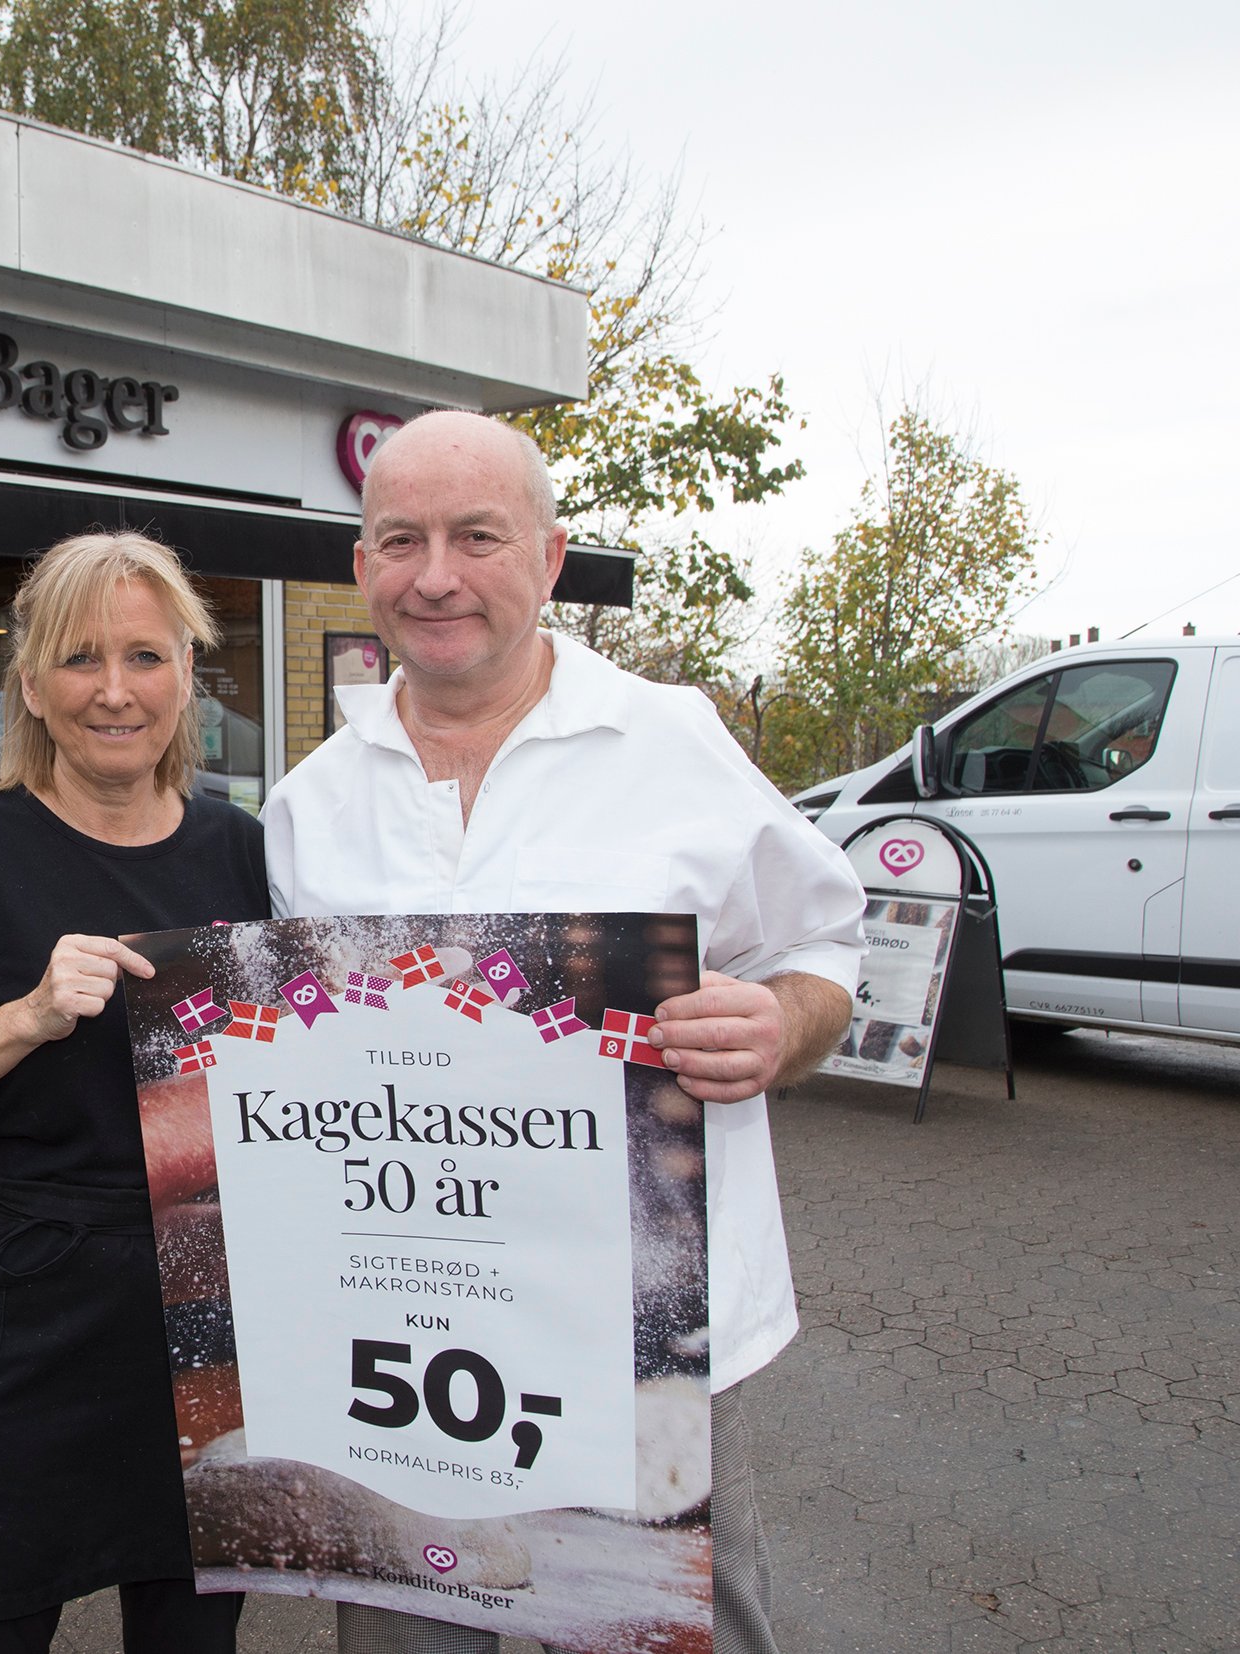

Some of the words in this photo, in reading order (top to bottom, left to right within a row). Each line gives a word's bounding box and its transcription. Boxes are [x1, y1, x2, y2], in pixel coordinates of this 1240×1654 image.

[865, 936, 909, 950] GBRØD
[1029, 1000, 1050, 1009] CVR
[365, 1050, 452, 1067] TILBUD
[232, 1084, 604, 1153] Kagekassen
[344, 1157, 416, 1214] 50
[434, 1158, 500, 1218] år
[349, 1254, 480, 1278] SIGTEBRØD
[490, 1268, 500, 1277] +
[340, 1275, 514, 1303] MAKRONSTANG
[405, 1313, 450, 1331] KUN
[347, 1338, 562, 1470] 50,-
[349, 1445, 483, 1482] NORMALPRIS
[490, 1470, 524, 1490] 83,-
[372, 1565, 514, 1610] KonditorBager
